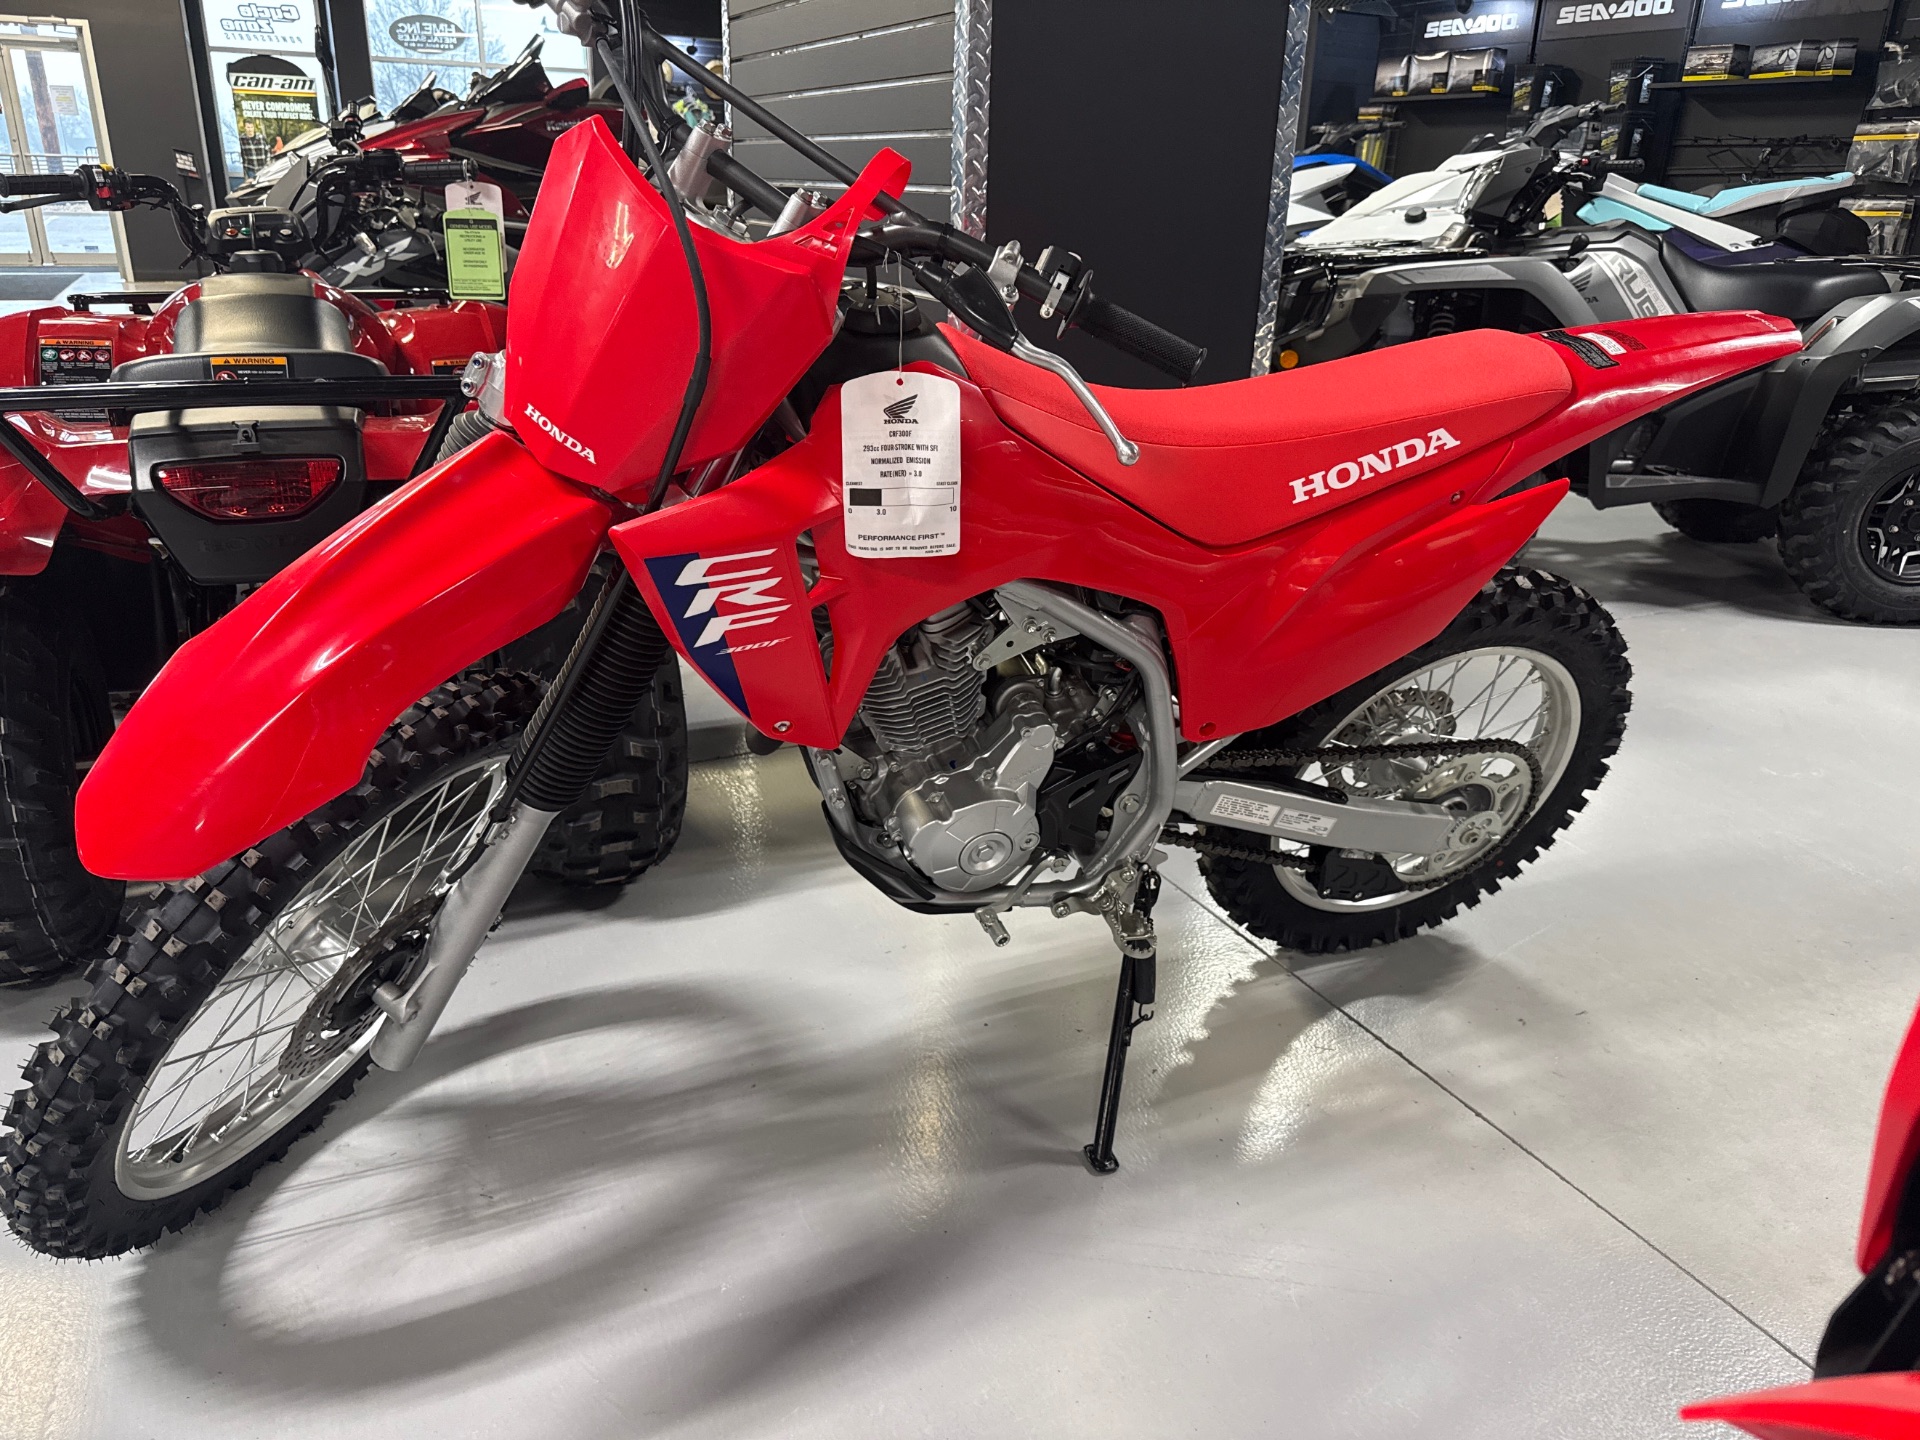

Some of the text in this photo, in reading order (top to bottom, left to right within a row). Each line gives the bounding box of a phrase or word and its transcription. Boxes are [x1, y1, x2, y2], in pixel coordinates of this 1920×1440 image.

[233, 75, 315, 90] can-am
[241, 100, 265, 111] NEVER
[524, 403, 597, 465] HONDA
[889, 430, 913, 438] CRF300F
[862, 444, 880, 452] 293cc
[916, 443, 929, 451] WITH
[870, 456, 931, 465] NORMALIZED EMISSION
[1289, 428, 1461, 505] HONDA
[876, 508, 887, 516] 3.0
[674, 548, 793, 649] CRF
[715, 636, 793, 656] 300F
